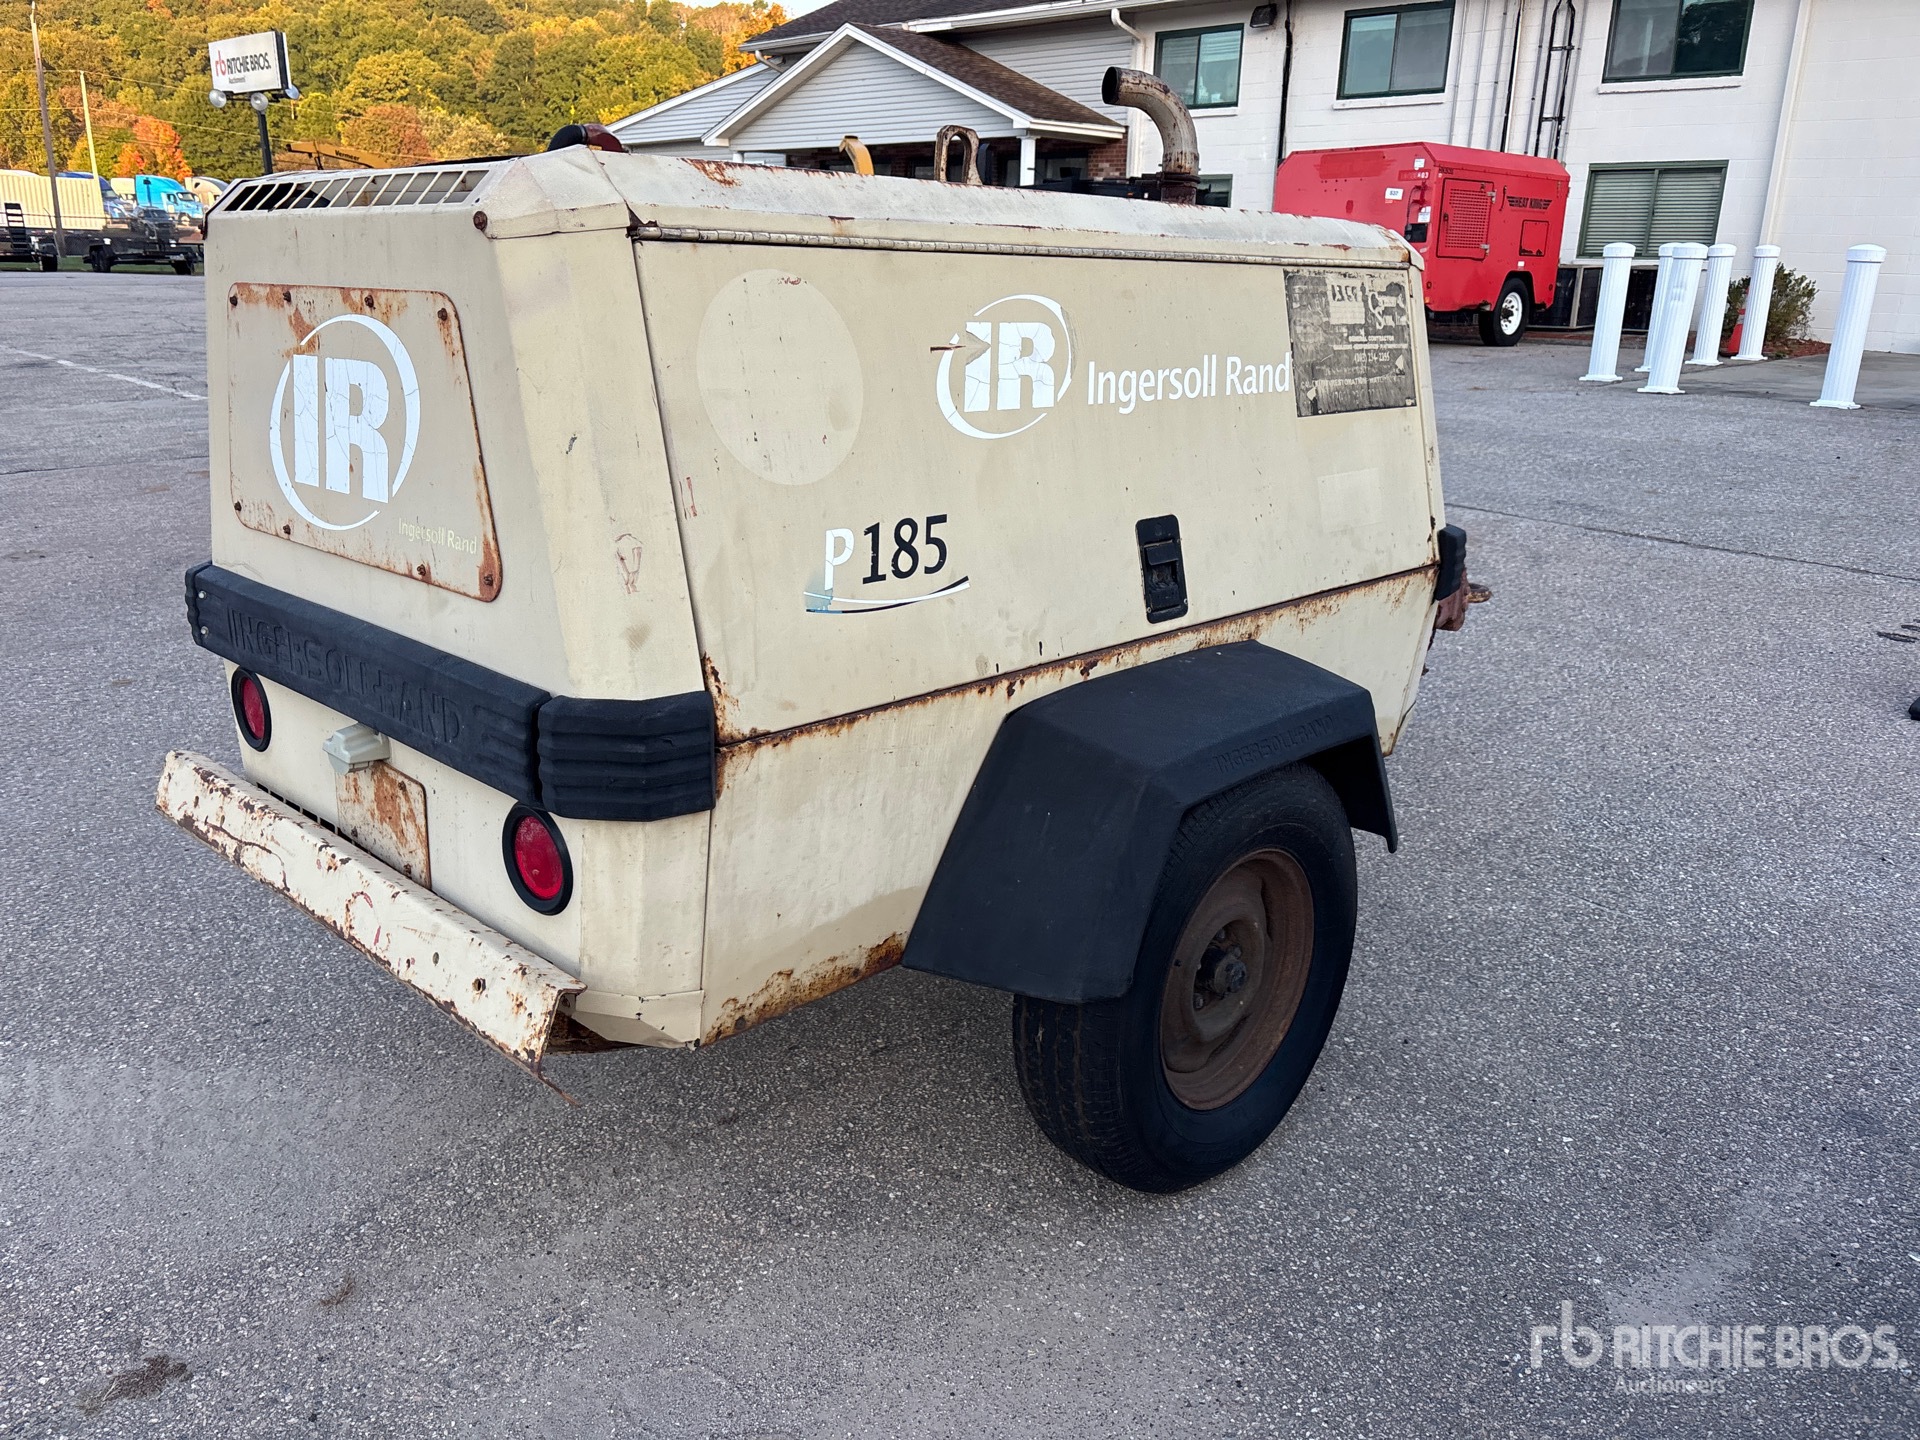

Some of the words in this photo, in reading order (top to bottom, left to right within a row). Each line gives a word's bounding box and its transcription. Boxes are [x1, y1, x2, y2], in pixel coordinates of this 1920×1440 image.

[226, 55, 250, 75] RITCHIE
[964, 321, 1055, 413] IR
[1087, 353, 1217, 415] Ingersoll
[1225, 351, 1291, 396] Rand
[293, 354, 389, 504] IR
[398, 517, 446, 547] Ingersoll
[446, 529, 478, 555] Rand
[862, 513, 948, 585] 185
